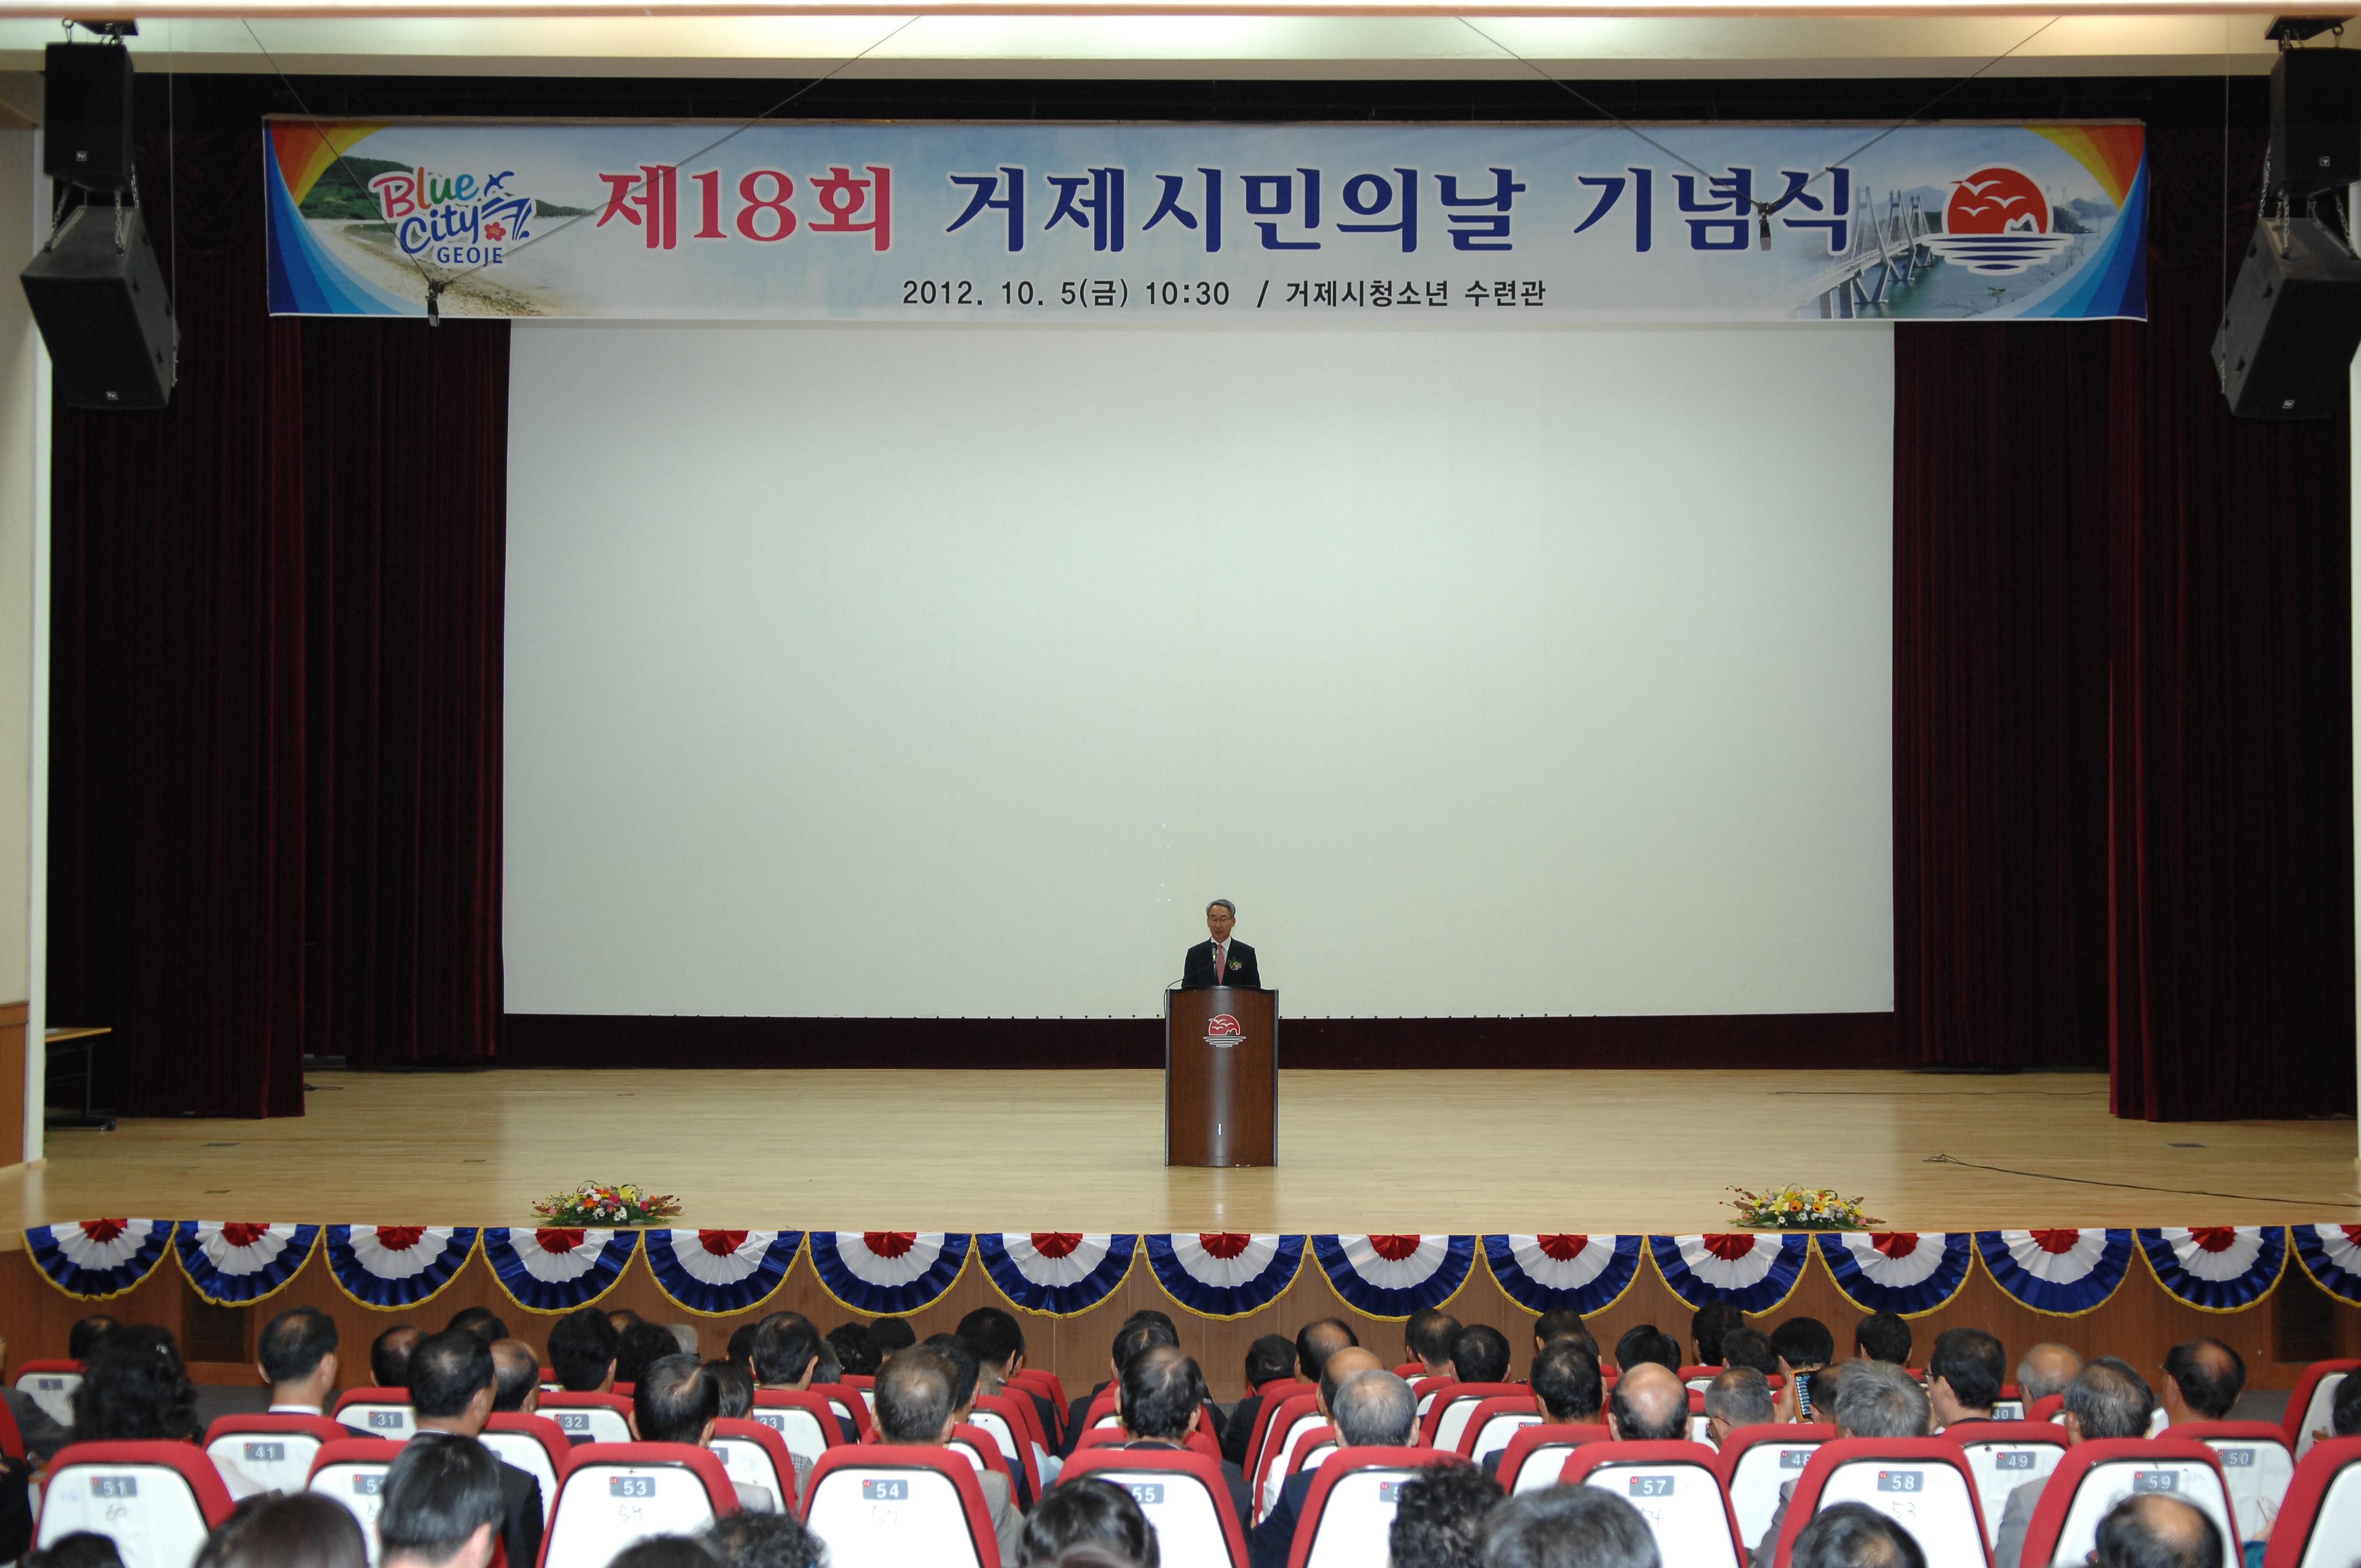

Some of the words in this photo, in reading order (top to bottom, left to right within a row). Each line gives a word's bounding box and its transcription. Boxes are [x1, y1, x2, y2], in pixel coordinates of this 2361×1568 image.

[373, 167, 479, 218] Blue
[596, 165, 890, 251] 제18회
[945, 167, 1526, 252] 거제시민의날
[1574, 167, 1850, 252] 기념식
[400, 204, 478, 254] City
[437, 247, 503, 266] GEOJE
[903, 280, 983, 305] 2012.
[1002, 281, 1044, 306] 10.
[1061, 279, 1128, 308] 5(금)
[1146, 281, 1230, 305] 10:30
[1286, 280, 1448, 307] 거제시청소년
[1465, 280, 1546, 307] 수련관
[377, 1414, 394, 1426] 31
[564, 1416, 582, 1428] 32
[1993, 1409, 2009, 1420] 30
[255, 1446, 274, 1458] 41
[1792, 1453, 1812, 1466] 48
[2229, 1452, 2249, 1465] 50
[2008, 1455, 2028, 1468] 49
[103, 1481, 124, 1495] 51
[366, 1479, 384, 1493] 5
[623, 1480, 646, 1496] 53
[1644, 1479, 1667, 1495] 57
[1892, 1475, 1915, 1490] 58
[2148, 1475, 2171, 1490] 59
[876, 1483, 899, 1498] 54
[1133, 1487, 1155, 1502] 55
